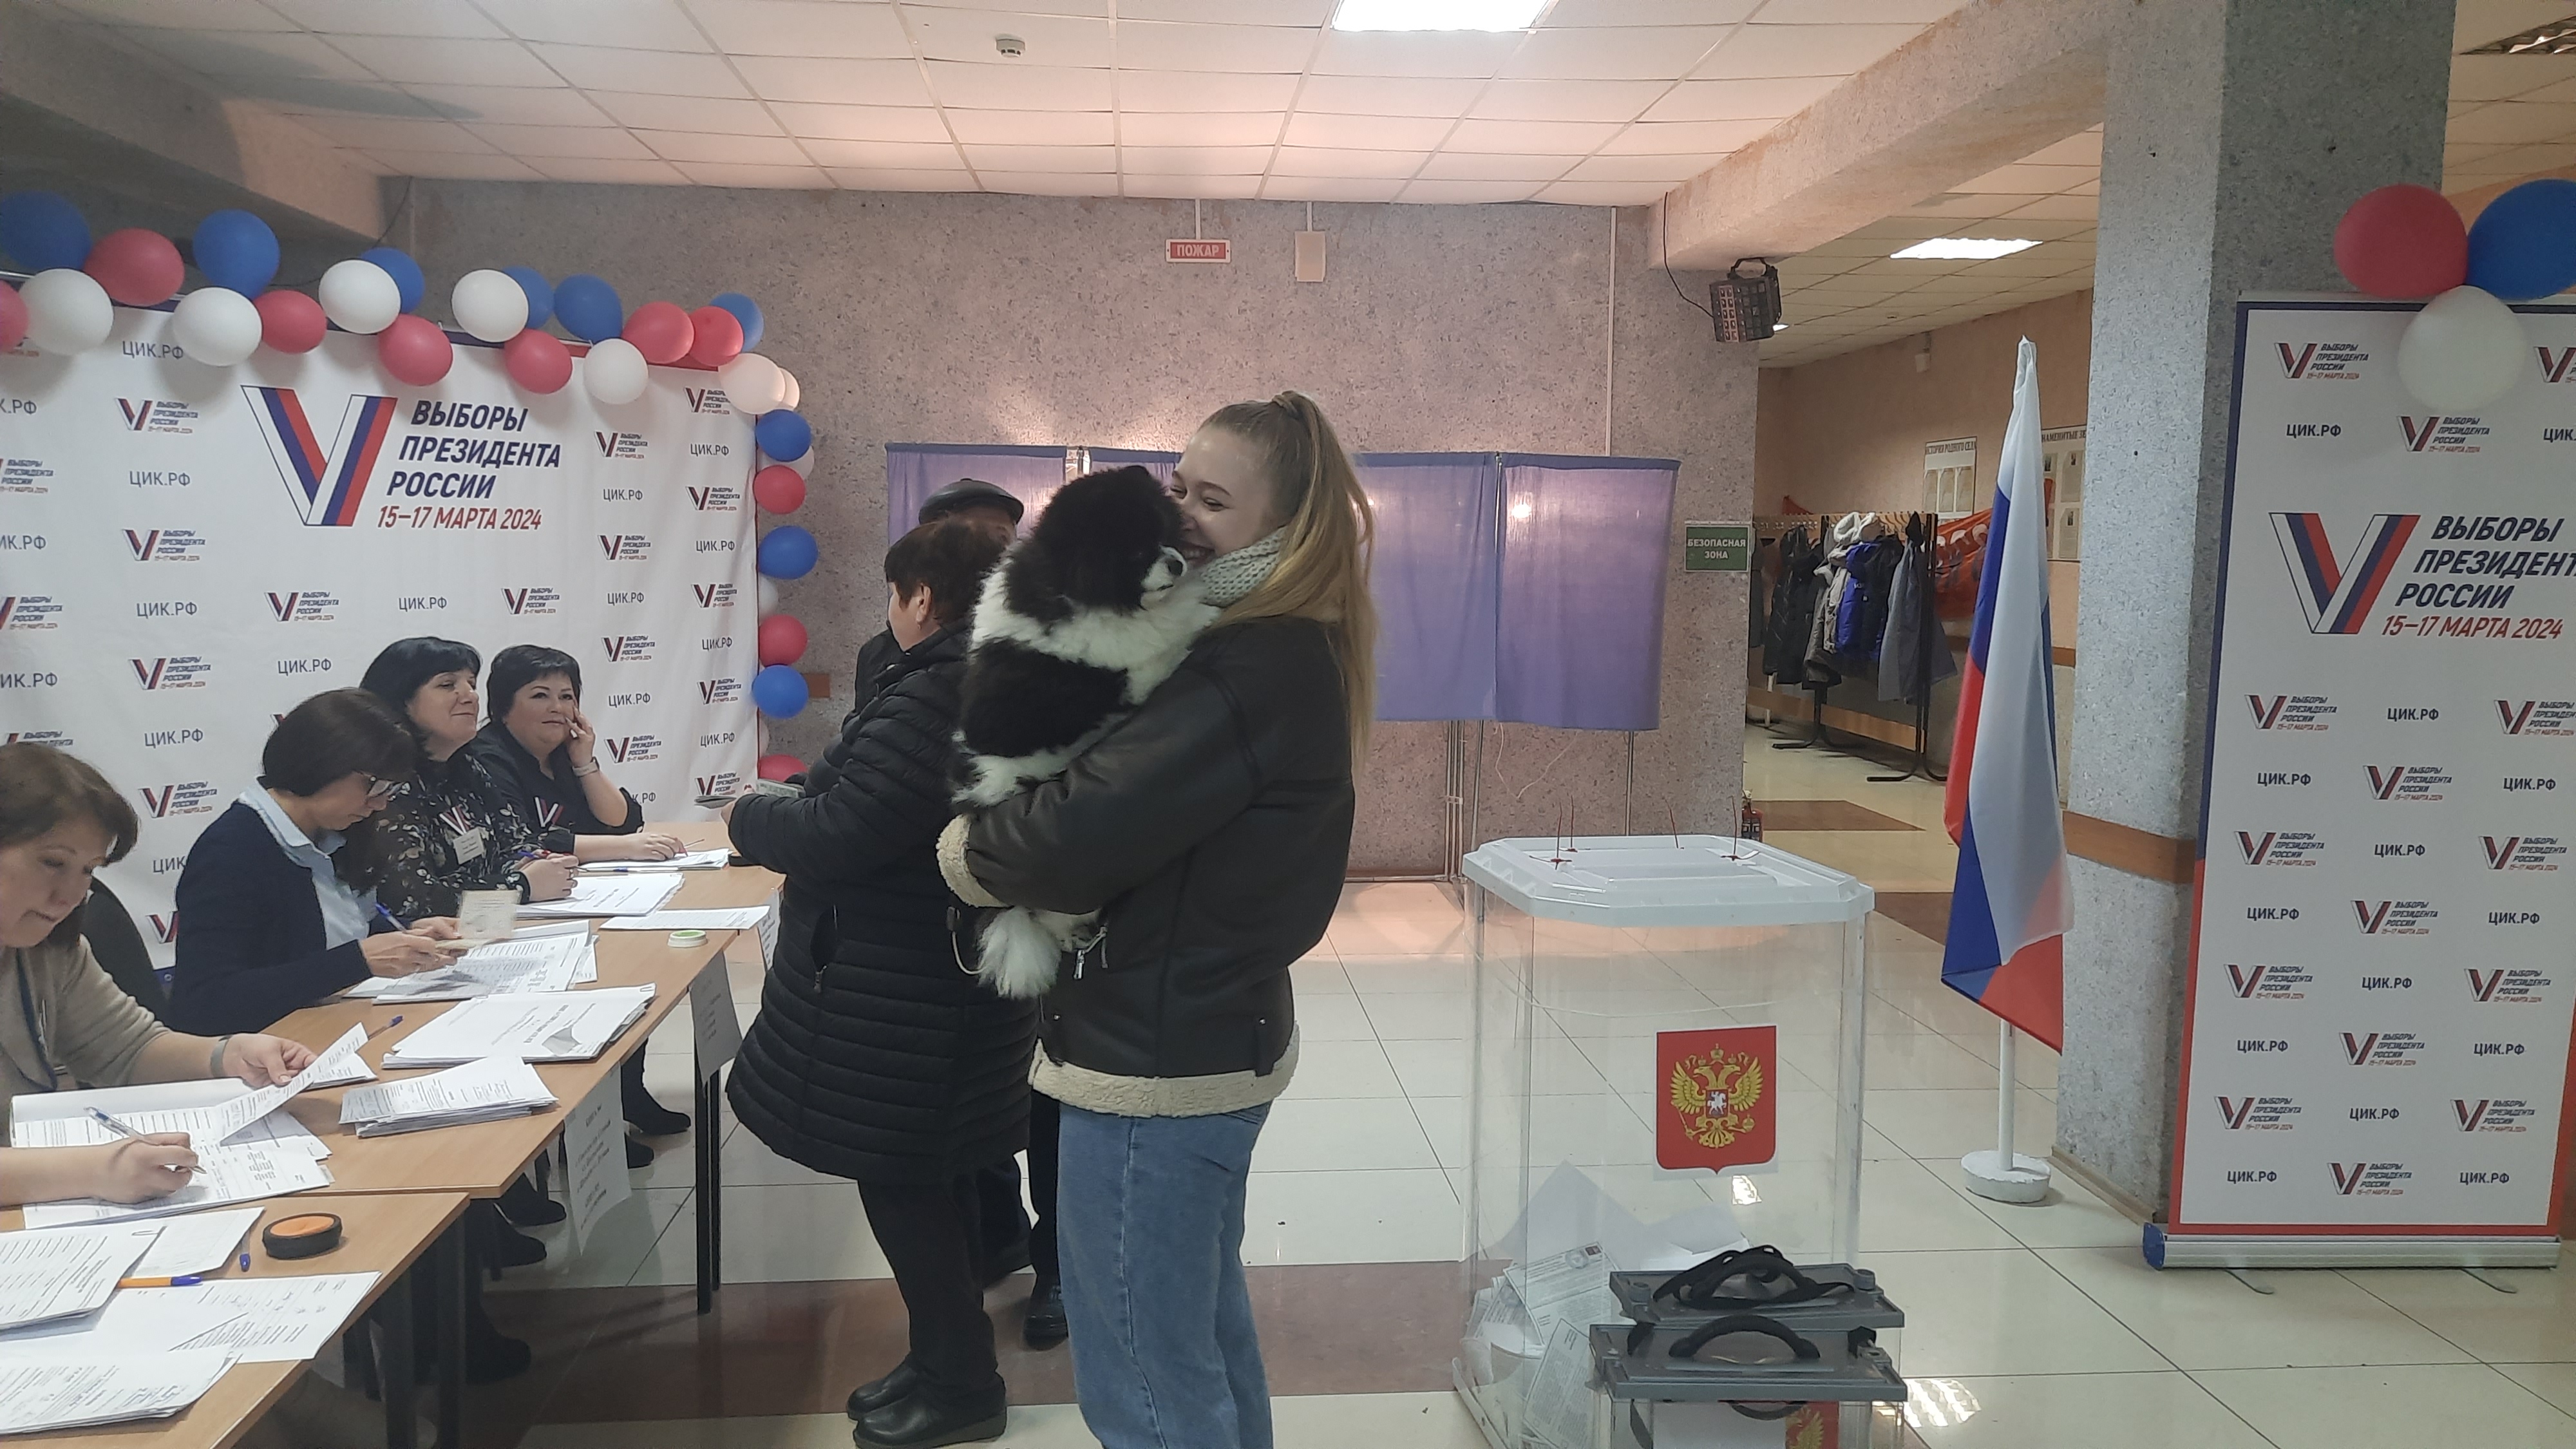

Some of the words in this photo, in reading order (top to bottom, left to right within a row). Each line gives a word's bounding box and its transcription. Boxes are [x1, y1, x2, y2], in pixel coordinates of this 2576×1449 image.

[1177, 244, 1219, 257] ПОЖАР
[122, 340, 184, 359] ЦИК.РФ
[0, 399, 37, 415] К.РФ
[410, 399, 529, 432] ВЫБОРЫ
[2041, 431, 2078, 442] НАМЕНИТЫЕ
[2286, 424, 2342, 439] ЦИК.РФ
[398, 435, 561, 469] ПРЕЗИДЕНТА
[690, 443, 729, 457] ЦИК.РФ
[129, 470, 191, 488] ЦИК.РФ
[386, 471, 497, 499] РОССИИ
[603, 489, 643, 502] ЦИК.РФ
[433, 507, 498, 529] МАРТА
[499, 508, 542, 530] 2024
[2430, 515, 2565, 542] ВЫБОРЫ
[0, 535, 46, 550] ИК.РФ
[696, 540, 735, 554] ЦИК.РФ
[1687, 538, 1746, 547] БЕЗОПАСНАЯ
[1705, 551, 1728, 559] ЗОНА
[2412, 549, 2576, 580] ПРЕЗИДЕНТ
[607, 592, 645, 607] ЦИК.РФ
[2394, 583, 2515, 609] РОССИИ
[137, 601, 198, 620] ЦИК.РФ
[399, 596, 447, 612] ЦИК.РФ
[2439, 616, 2510, 639] МАРТА
[2510, 618, 2563, 639] 2024
[702, 636, 733, 651] ЦИК.РФ
[278, 658, 332, 677] ЦИК.РФ
[0, 672, 58, 688] ИК.РФ
[608, 692, 650, 708] ЦИК.РФ
[2387, 708, 2439, 723] ЦИК.РФ
[144, 728, 204, 749] ЦИК.РФ
[700, 732, 735, 748] ЦИК.РФ
[2257, 772, 2311, 787] ЦИК.РФ
[2503, 777, 2556, 792] ЦИК.РФ
[2374, 844, 2426, 858] ЦИК.РФ
[153, 855, 185, 875] ЦИК
[2247, 907, 2300, 922] ЦИК.РФ
[2488, 912, 2540, 926] ЦИК.РФ
[2362, 977, 2412, 991] ЦИК.РФ
[2237, 1039, 2288, 1054] ЦИК.РФ
[2474, 1043, 2525, 1057] ЦИК.РФ
[2349, 1108, 2400, 1122] ЦИК.РФ
[2227, 1170, 2277, 1184] ЦИК.РФ
[2459, 1172, 2510, 1186] ЦИК.РФ
